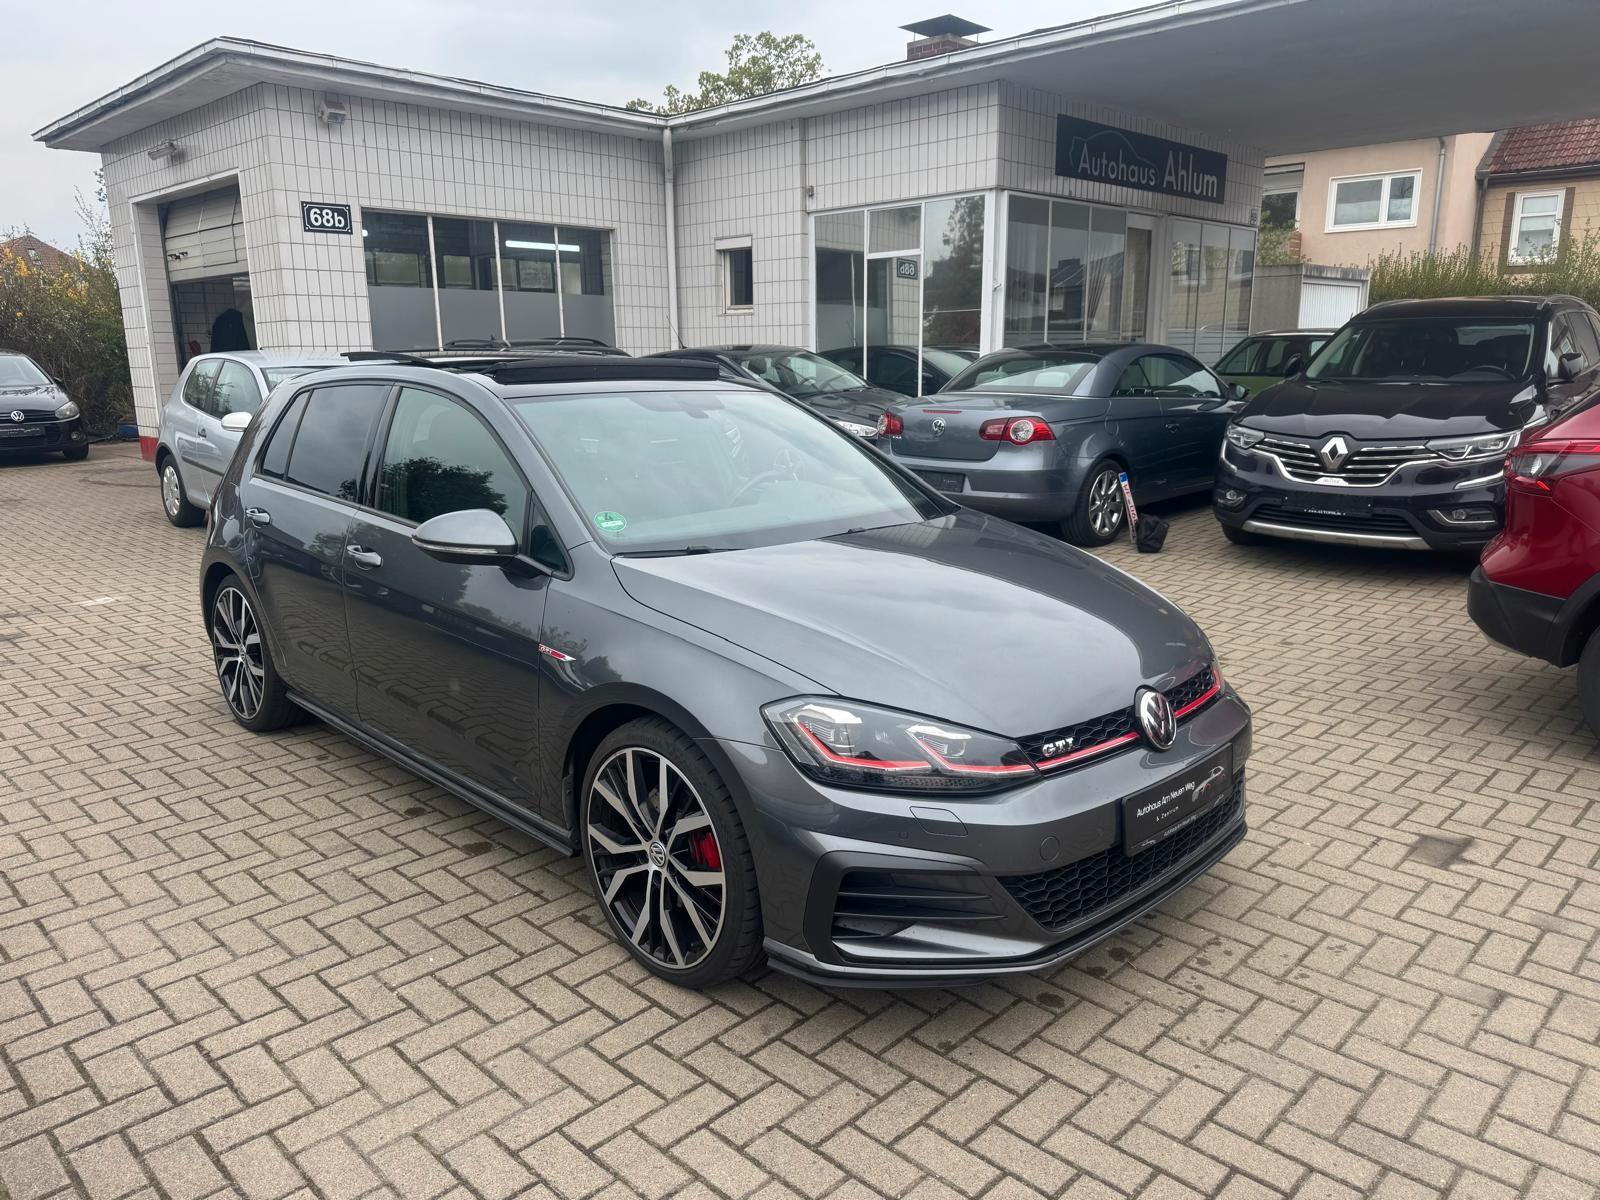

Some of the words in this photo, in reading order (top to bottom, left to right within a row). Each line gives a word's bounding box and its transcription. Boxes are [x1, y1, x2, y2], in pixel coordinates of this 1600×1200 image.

[1078, 143, 1156, 186] Autohaus
[1162, 150, 1217, 198] Ahlum
[310, 207, 345, 227] 68b
[1042, 737, 1074, 757] GTI
[1136, 799, 1161, 818] Autohaus
[1161, 795, 1171, 805] Am
[1170, 786, 1185, 799] Neuen
[1185, 781, 1196, 791] Weg
